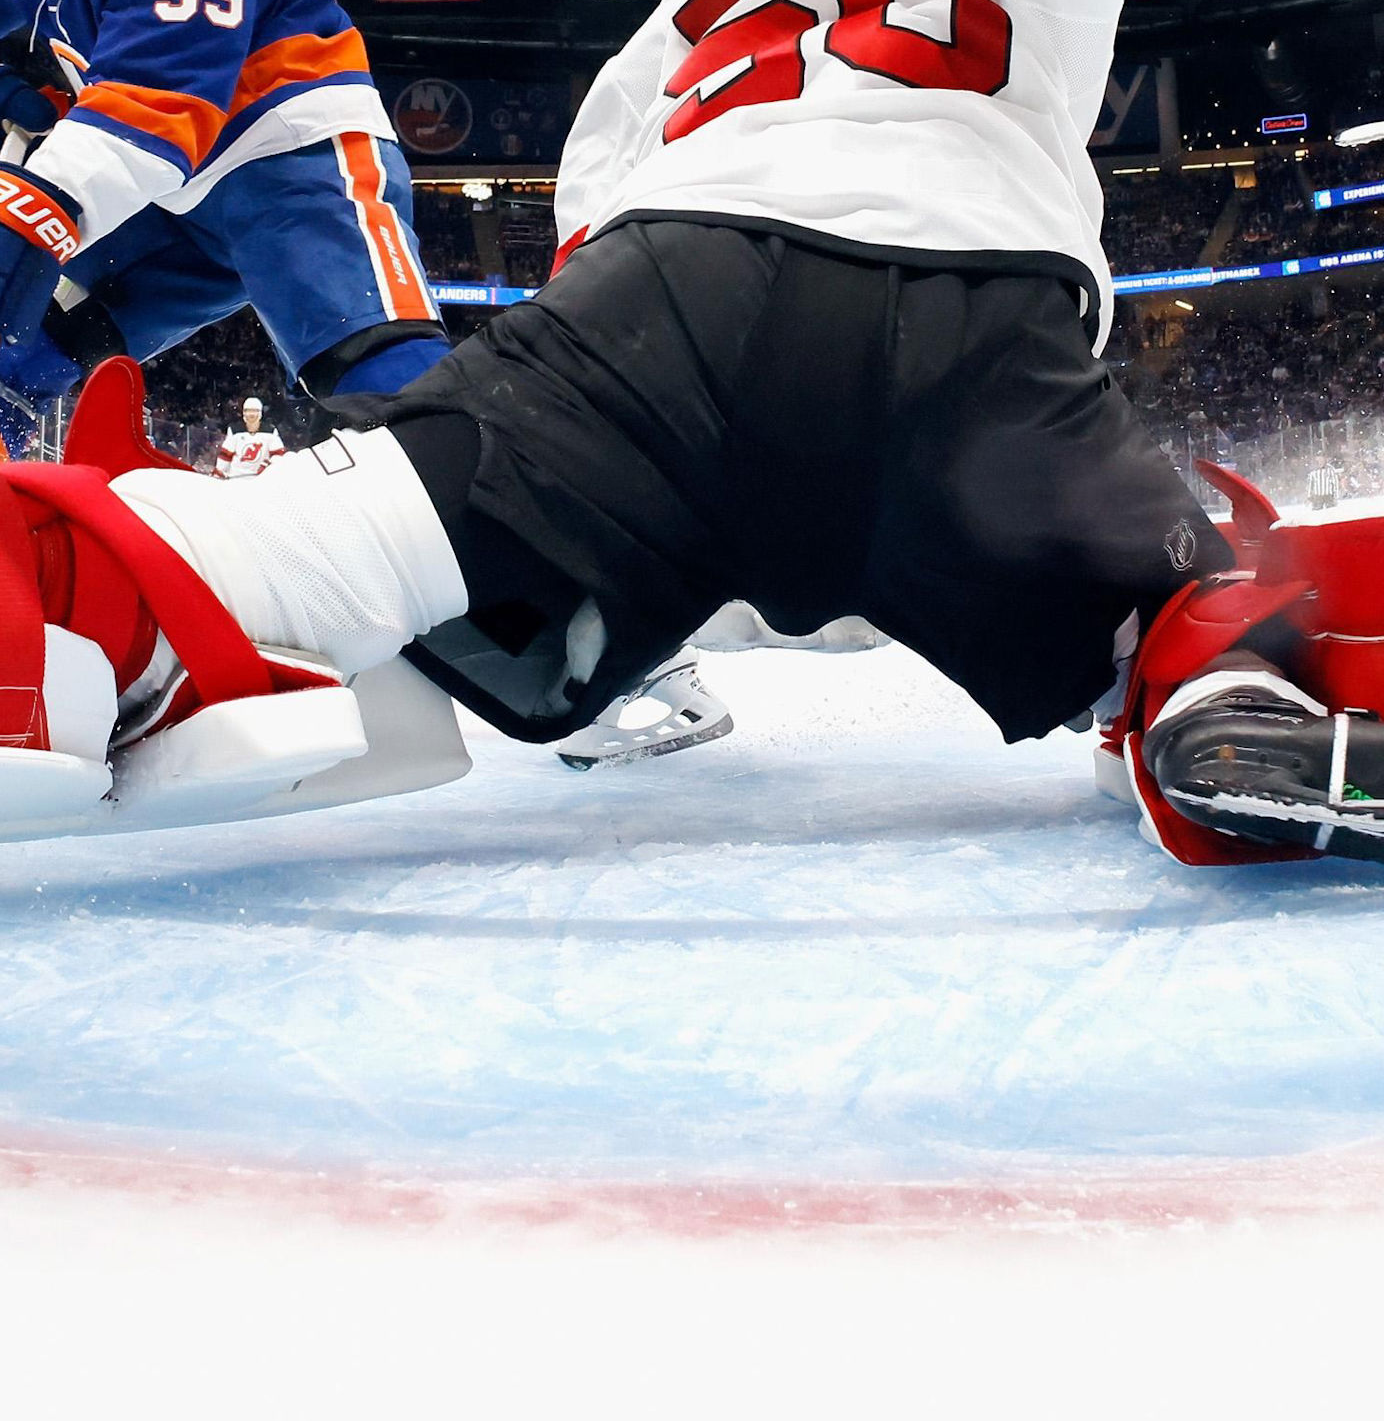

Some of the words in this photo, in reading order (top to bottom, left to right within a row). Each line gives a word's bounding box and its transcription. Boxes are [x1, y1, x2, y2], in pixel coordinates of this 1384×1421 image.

[379, 225, 408, 286] BAUER
[1319, 255, 1340, 267] UBS
[1340, 250, 1372, 265] ARENA
[1373, 248, 1384, 259] IS
[1212, 267, 1261, 281] WITHAMEX
[430, 287, 488, 302] LANDERS
